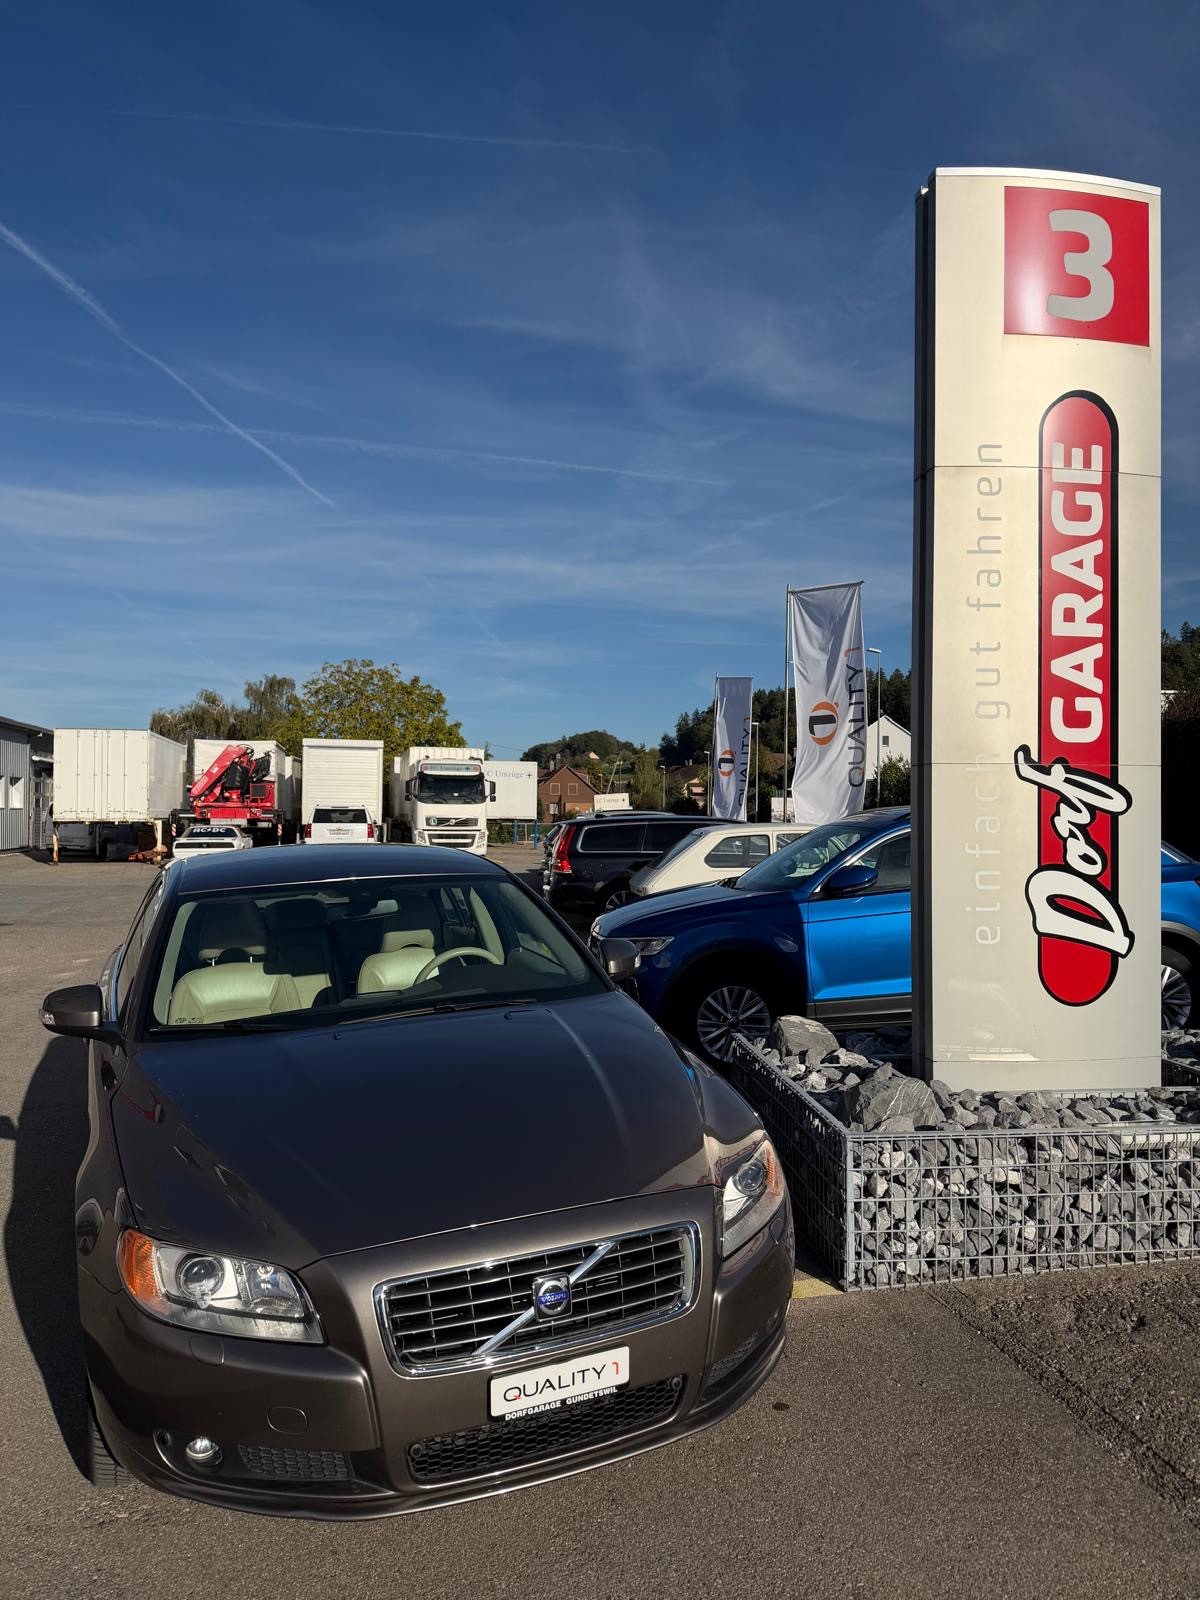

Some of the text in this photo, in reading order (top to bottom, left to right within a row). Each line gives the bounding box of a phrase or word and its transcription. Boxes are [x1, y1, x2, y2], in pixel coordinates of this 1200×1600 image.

[1046, 208, 1115, 322] 3
[847, 664, 865, 788] QUALITY
[965, 443, 1011, 945] einfach gut fahren
[1016, 442, 1133, 957] Dorf GARAGE
[503, 1361, 619, 1402] QUALITY 1
[505, 1386, 618, 1421] DORFGARAGE GUNDETSWIL
